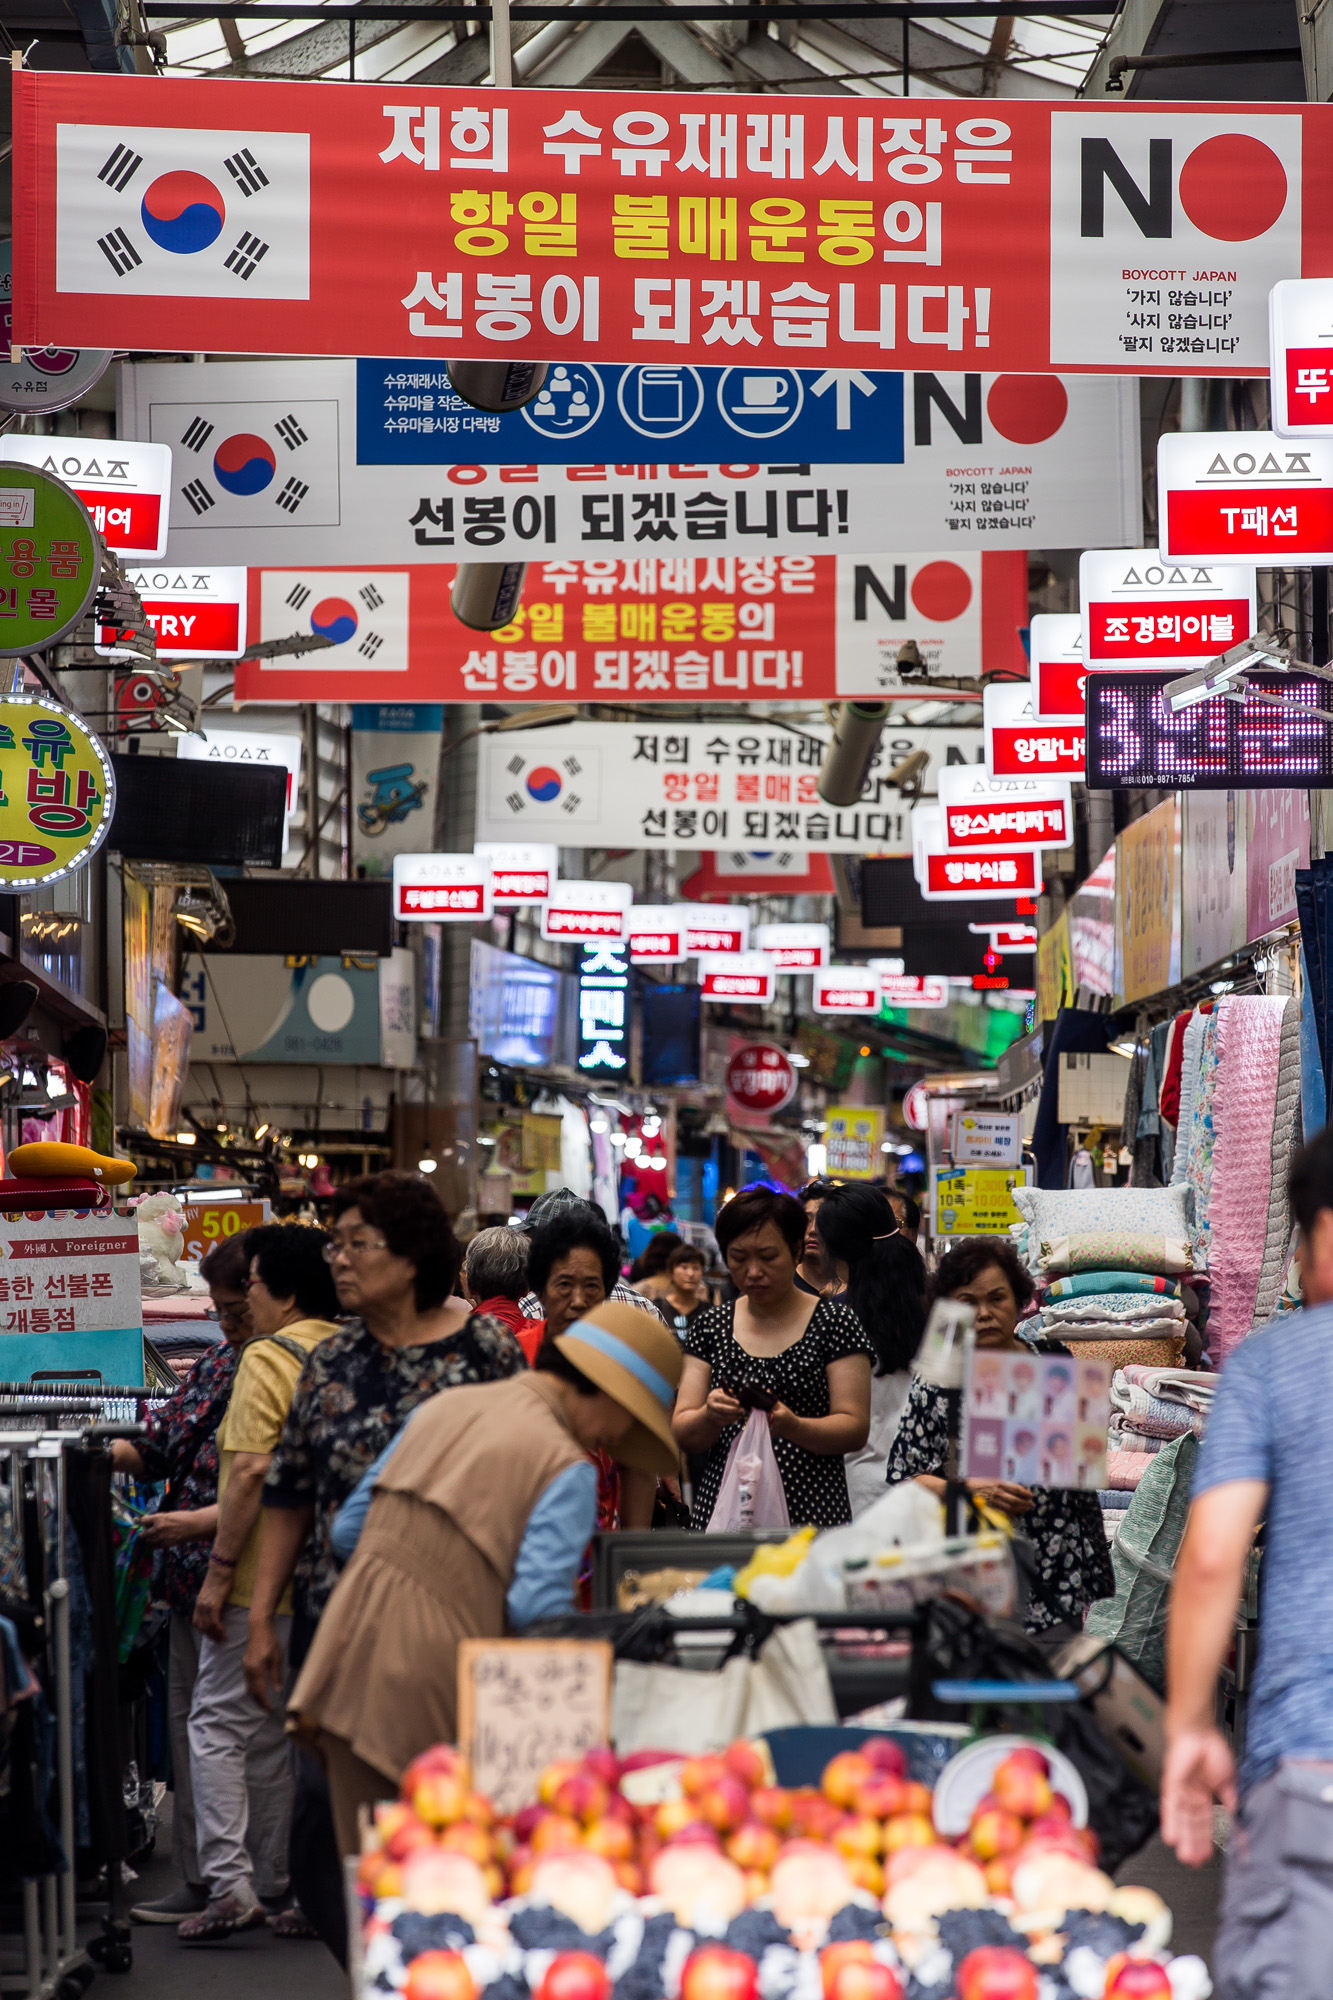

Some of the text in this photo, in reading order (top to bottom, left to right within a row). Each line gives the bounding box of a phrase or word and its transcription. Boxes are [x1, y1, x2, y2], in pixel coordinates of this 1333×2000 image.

[379, 106, 1013, 185] 저희 수유재래시장은
[450, 189, 942, 267] 항일 불매운동의
[1122, 269, 1237, 282] BOYCOTT JAPAN
[401, 271, 991, 351] 선봉이 되겠습니다!
[11, 381, 48, 393] 수유점
[1294, 367, 1333, 404] 뚜
[383, 395, 435, 412] 수유마을
[383, 416, 501, 434] 수유마을시장 다락방
[946, 466, 1032, 477] BOYCOTT JAPAN
[408, 488, 850, 547] 선봉이 되겠습니다!
[1220, 505, 1298, 537] T패션
[542, 556, 816, 595] 수유재래시장은
[581, 602, 776, 642] 불매운동의
[1103, 614, 1235, 644] 조경희이불
[459, 649, 804, 692] 선봉이 되겠습니다!
[633, 735, 689, 765] 저희
[1013, 736, 1085, 764] 양말나
[662, 771, 721, 804] 항일
[1141, 774, 1196, 785] 010-9871-7854
[0, 767, 97, 832] 방
[641, 808, 904, 843] 선봉이 되겠습니다!
[944, 859, 1018, 884] 행복식품
[24, 1242, 59, 1255] 外國人
[66, 1240, 128, 1253] Foreigner
[44, 1272, 114, 1299] 선불폰
[7, 1306, 76, 1334] 개통점
